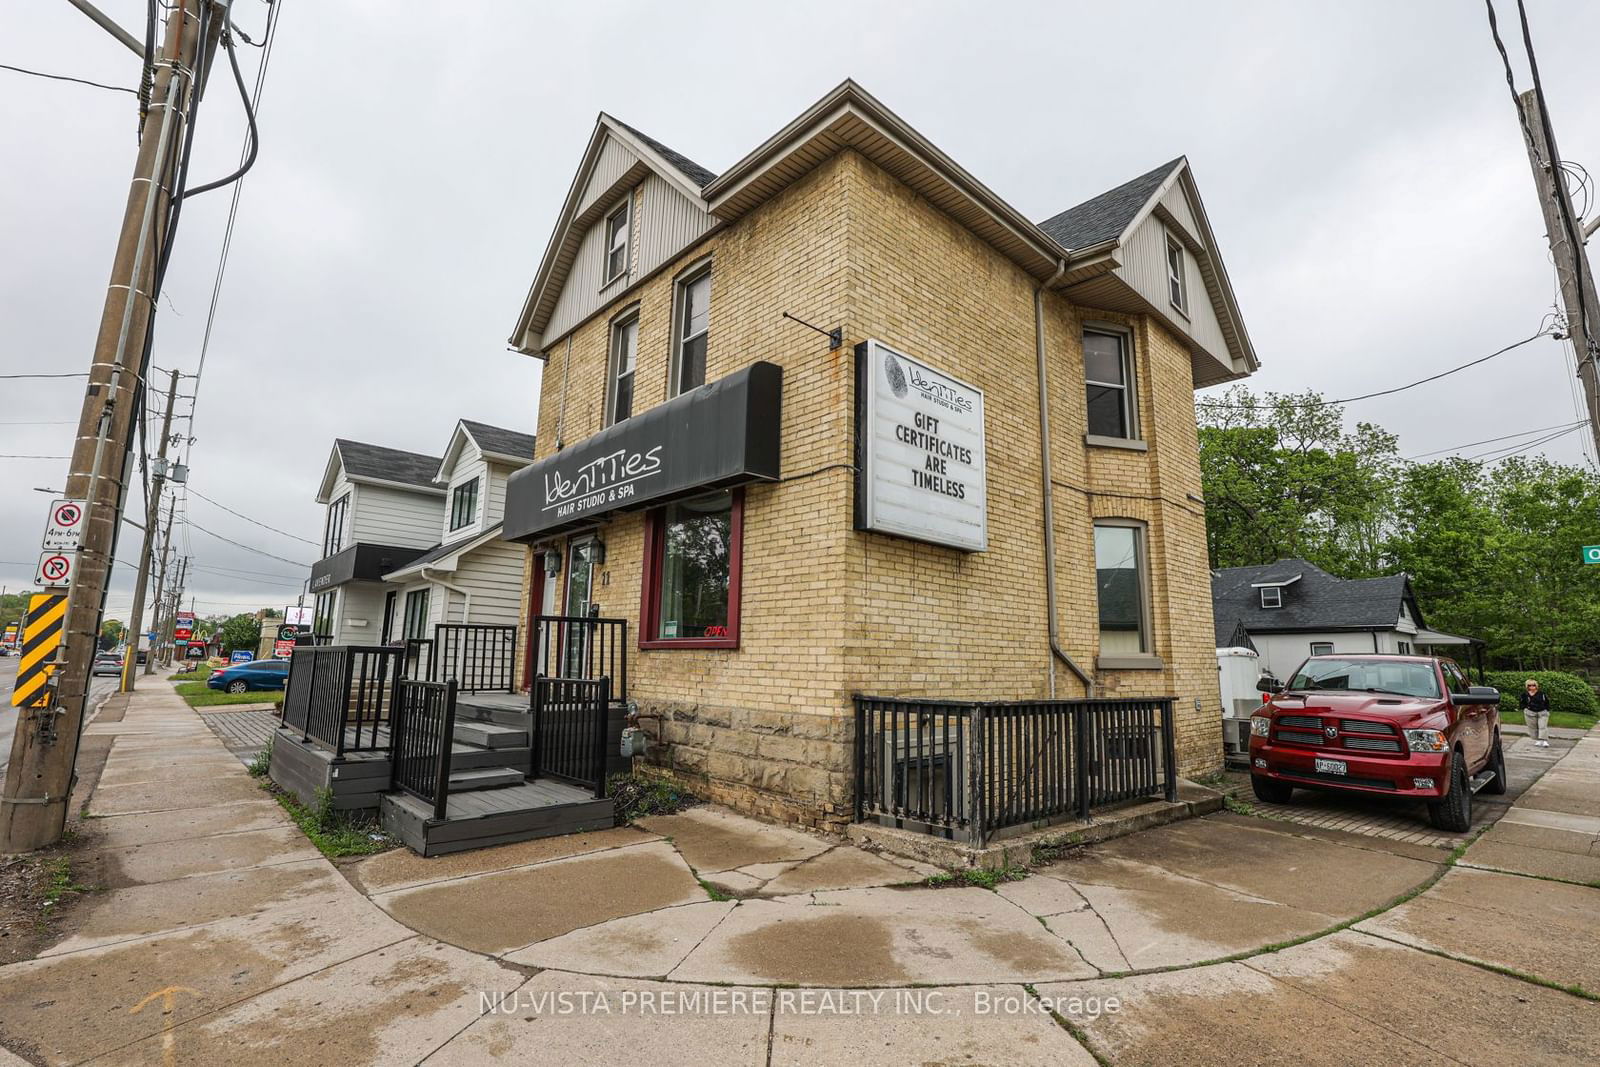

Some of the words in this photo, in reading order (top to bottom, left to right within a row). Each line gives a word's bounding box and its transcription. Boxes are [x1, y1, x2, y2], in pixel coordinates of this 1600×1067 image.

[920, 392, 932, 401] HAIR
[933, 397, 949, 409] STUDIO
[954, 406, 962, 414] SPA
[914, 411, 940, 434] GIFT
[896, 424, 972, 465] CERTIFICATES
[925, 454, 947, 476] ARE
[912, 468, 965, 499] TIMELESS
[557, 502, 574, 518] HAIR
[577, 493, 605, 511] STUDIO
[608, 489, 616, 502] &
[617, 484, 635, 499] SPA
[602, 570, 610, 585] 11
[704, 625, 728, 637] OPEN
